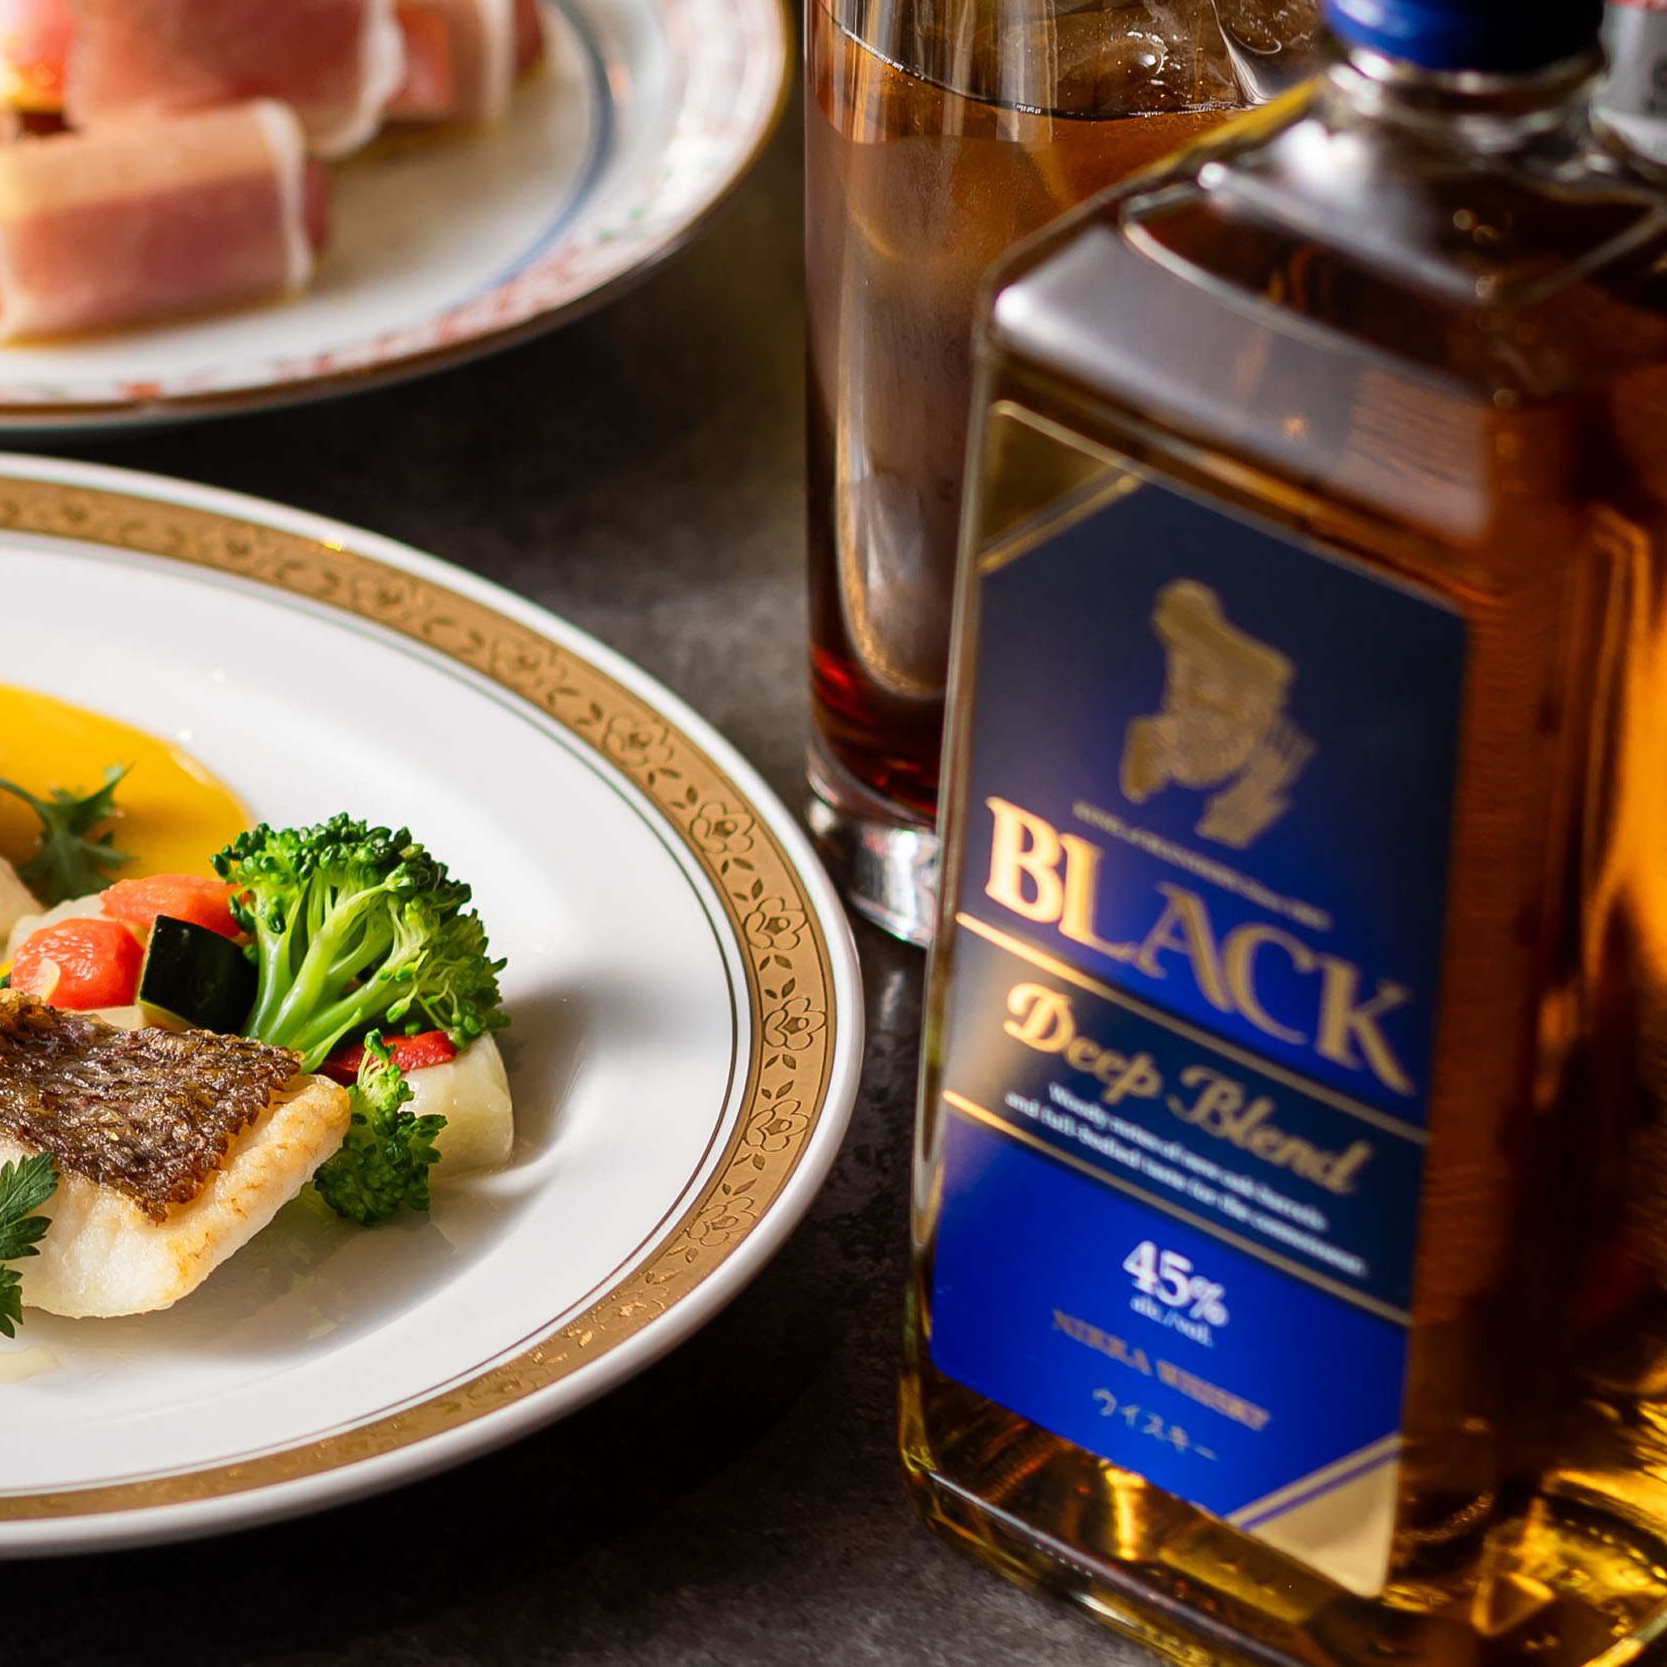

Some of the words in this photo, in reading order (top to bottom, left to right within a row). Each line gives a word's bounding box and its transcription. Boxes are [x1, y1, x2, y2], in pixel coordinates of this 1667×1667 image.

[984, 795, 1416, 1097] BLACK
[1002, 982, 1164, 1104] Deep
[1166, 1064, 1371, 1196] Blend
[1122, 1240, 1229, 1328] 45%
[1092, 1388, 1218, 1462] ウイスキー
